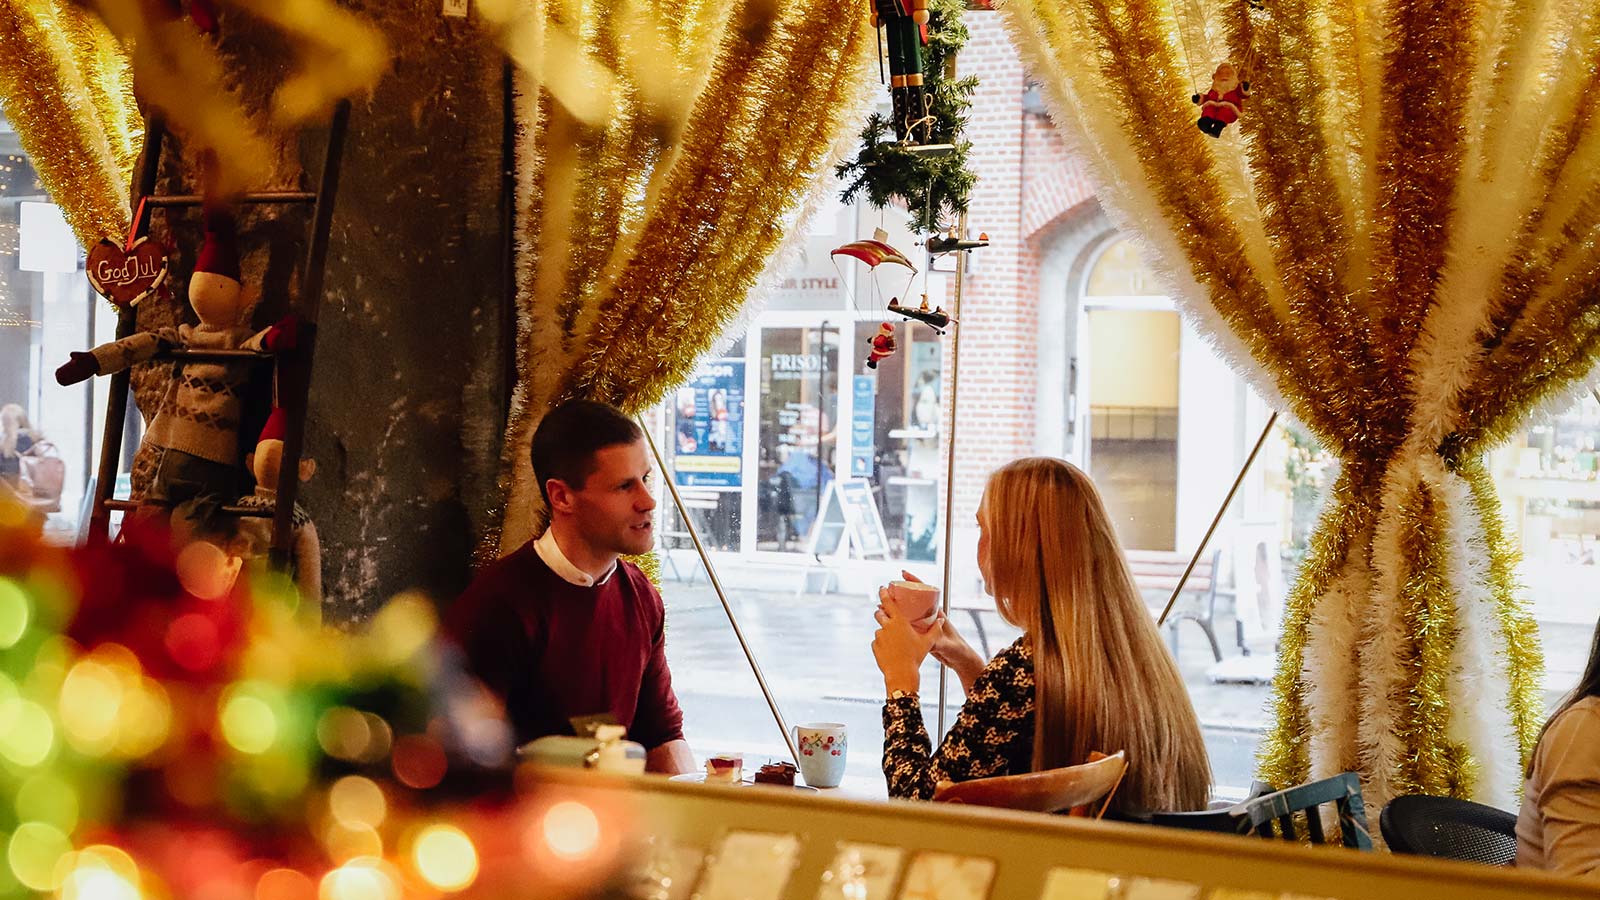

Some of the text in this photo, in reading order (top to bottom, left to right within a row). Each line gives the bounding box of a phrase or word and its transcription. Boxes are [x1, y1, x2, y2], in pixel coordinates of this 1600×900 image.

[97, 255, 158, 286] God Jul
[801, 277, 839, 289] STYLE
